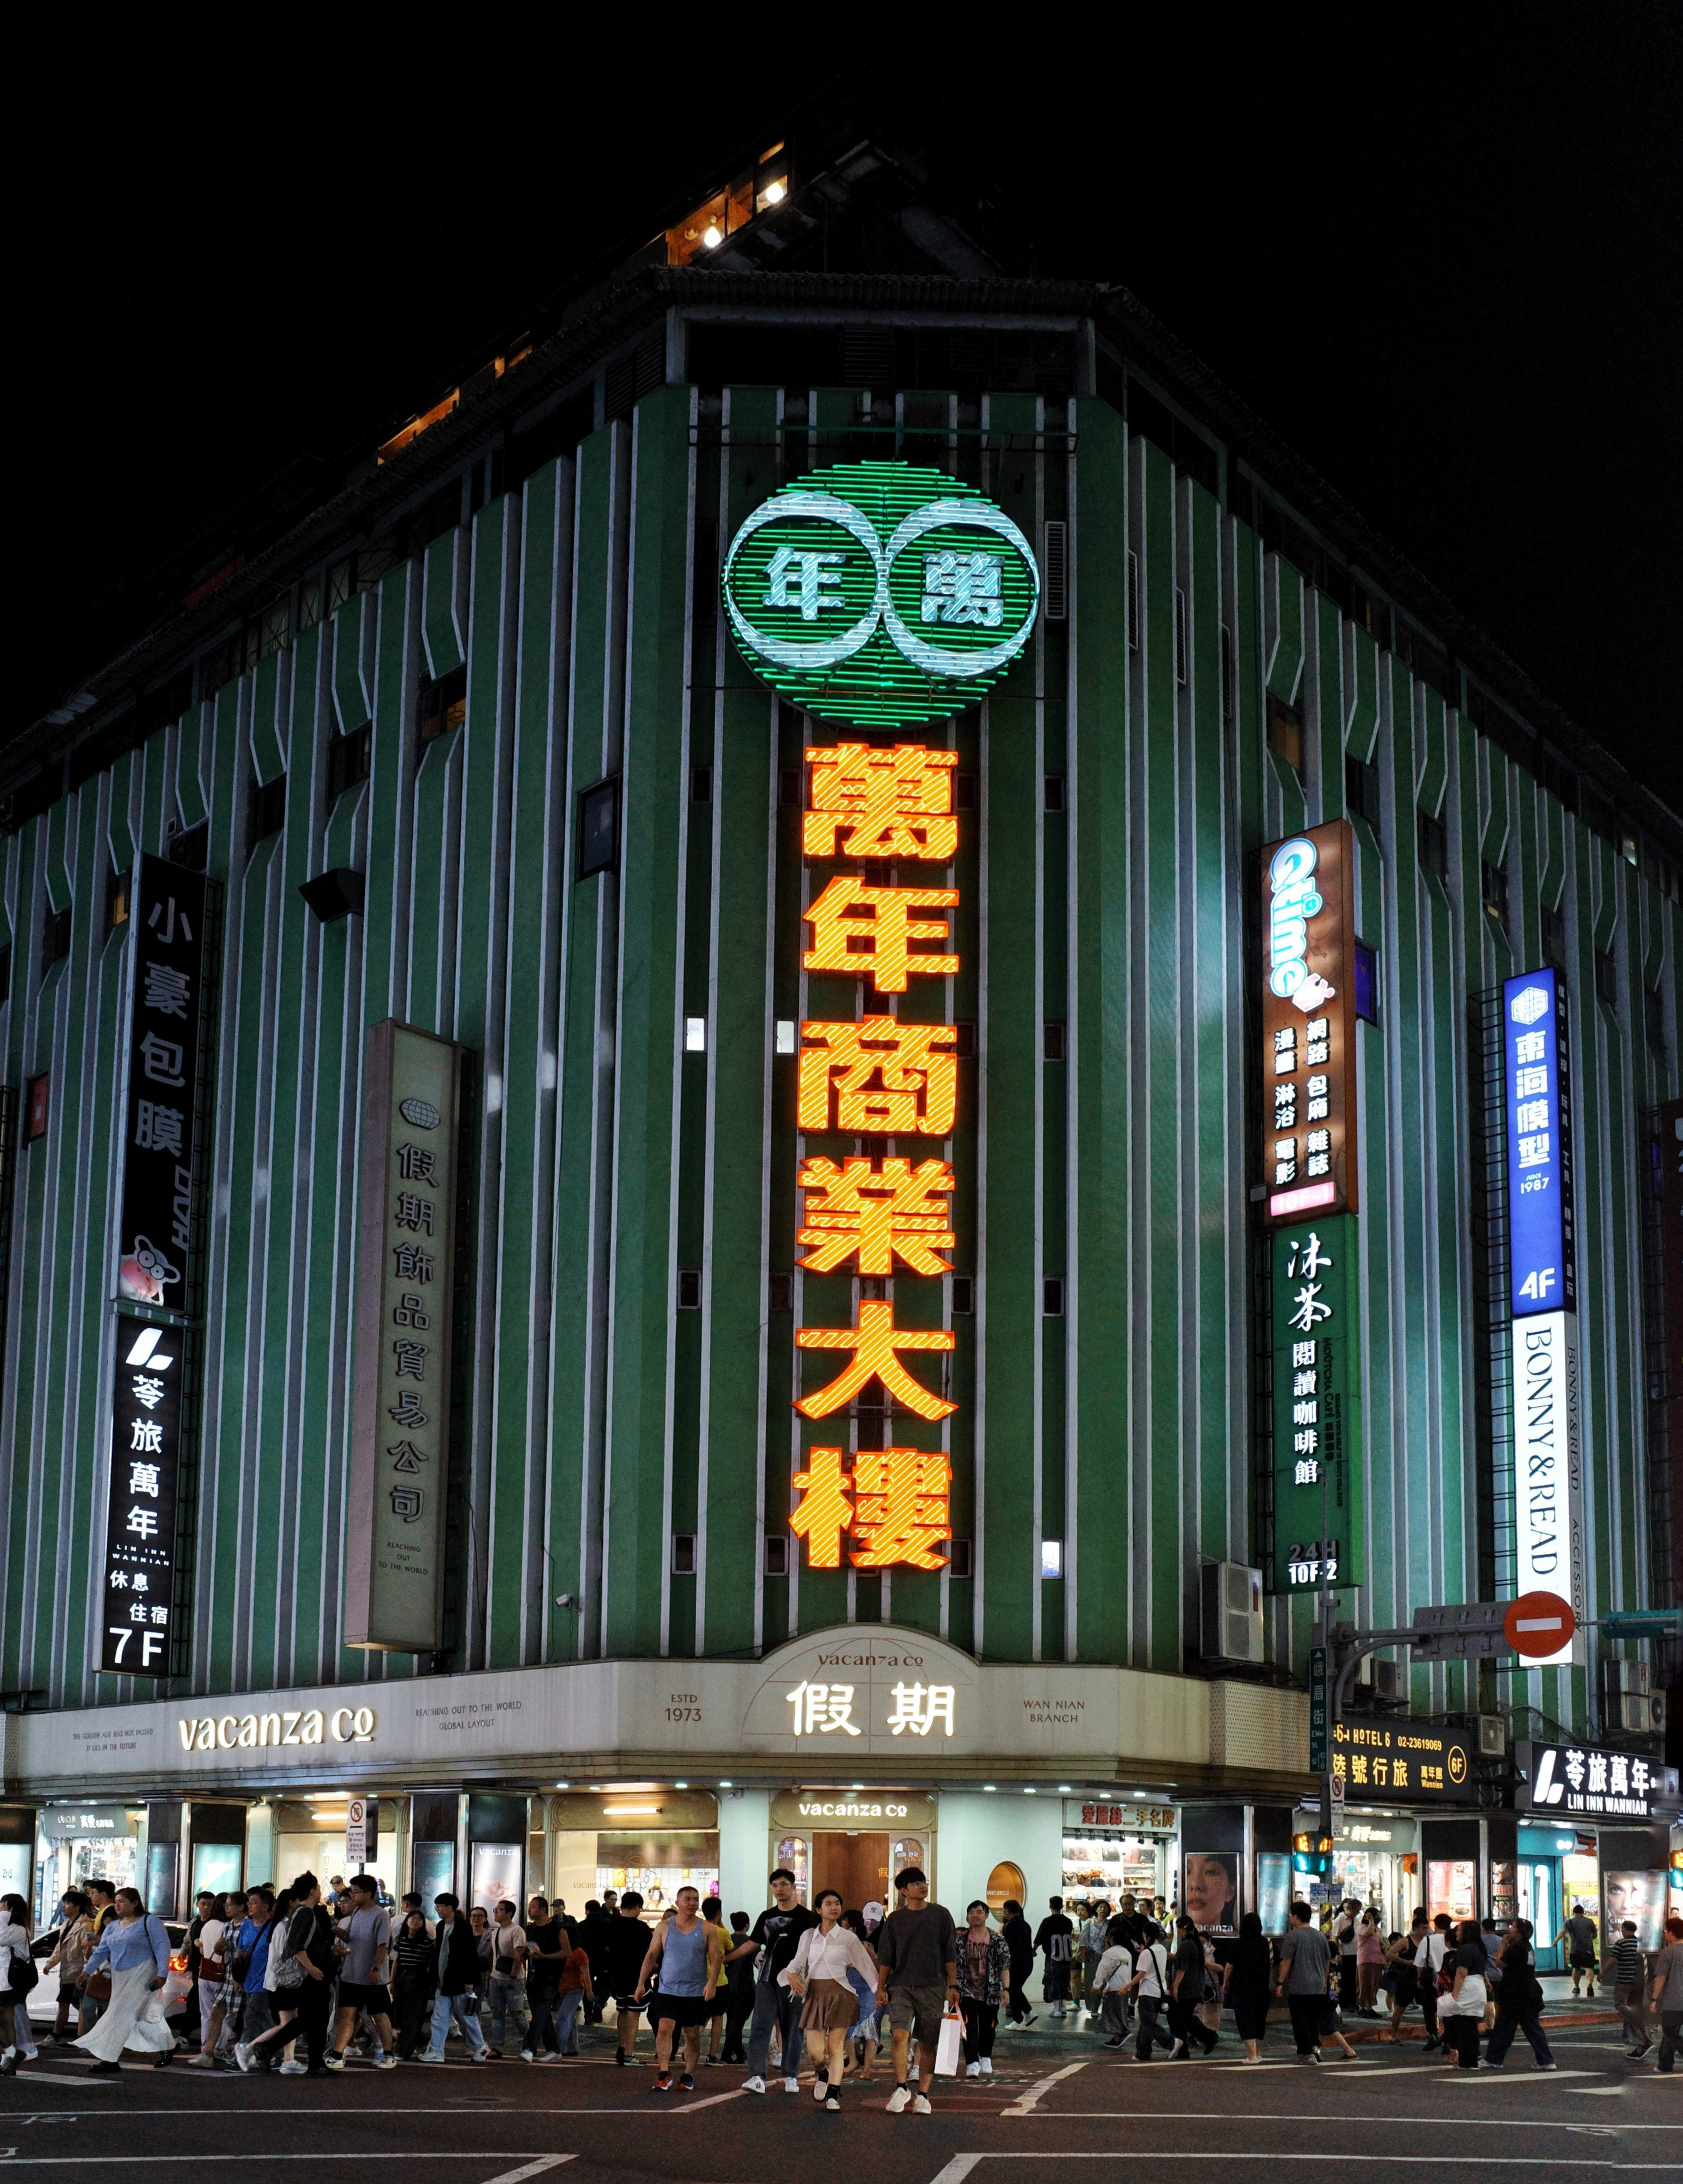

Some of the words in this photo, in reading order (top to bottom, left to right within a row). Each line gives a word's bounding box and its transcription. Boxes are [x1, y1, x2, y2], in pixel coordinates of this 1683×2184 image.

[135, 896, 193, 1158] 小豪包膜
[1306, 1017, 1329, 1066] 網路
[1274, 1027, 1295, 1075] 漫畫
[1275, 1082, 1296, 1129] 淋浴
[1307, 1074, 1328, 1122] 包廂
[1515, 1030, 1550, 1168] 東海模型
[789, 743, 959, 1570] 萬年商業大樓
[1275, 1137, 1296, 1185] 電影
[1307, 1128, 1329, 1177] 雜誌
[1277, 1185, 1330, 1212] 10F-1
[1520, 1176, 1550, 1194] 1987
[1519, 1267, 1556, 1299] 4F
[387, 1142, 440, 1524] 假期飾品貿易公司
[1293, 1339, 1317, 1485] 閱讀咖啡館
[127, 1374, 165, 1540] 苓旅萬年
[112, 1553, 169, 1566] WANNIAN
[116, 1544, 137, 1552] LIN
[387, 1541, 421, 1552] REACHING
[110, 1570, 149, 1592] 休息
[405, 1566, 428, 1574] WORLD
[1572, 1517, 1581, 1633] ACCESSORY
[130, 1603, 168, 1625] 住宿
[109, 1627, 165, 1667] 7F
[452, 1705, 466, 1714] OUT
[481, 1704, 493, 1712] THE
[496, 1701, 521, 1710] WORLD
[671, 1694, 698, 1703] ESTD
[785, 1680, 956, 1737] 假期
[1023, 1700, 1050, 1709] WAN
[1056, 1701, 1084, 1709] NIAN
[1313, 1662, 1324, 1725] 峨眉街
[178, 1709, 325, 1751] vacanza
[439, 1722, 465, 1730] GLOBAL
[468, 1719, 494, 1728] LAYOUT
[665, 1708, 702, 1722] 1973
[1030, 1714, 1078, 1722] BRANCH
[1385, 1732, 1391, 1747] 6
[1398, 1736, 1442, 1751] 02-23619069
[1451, 1757, 1463, 1774] 6F
[1565, 1749, 1649, 1797] 苓旅萬年
[799, 1803, 881, 1817] vacanza
[1567, 1793, 1584, 1810] LIN
[1586, 1795, 1603, 1812] INN
[1605, 1797, 1647, 1815] WANNIAN
